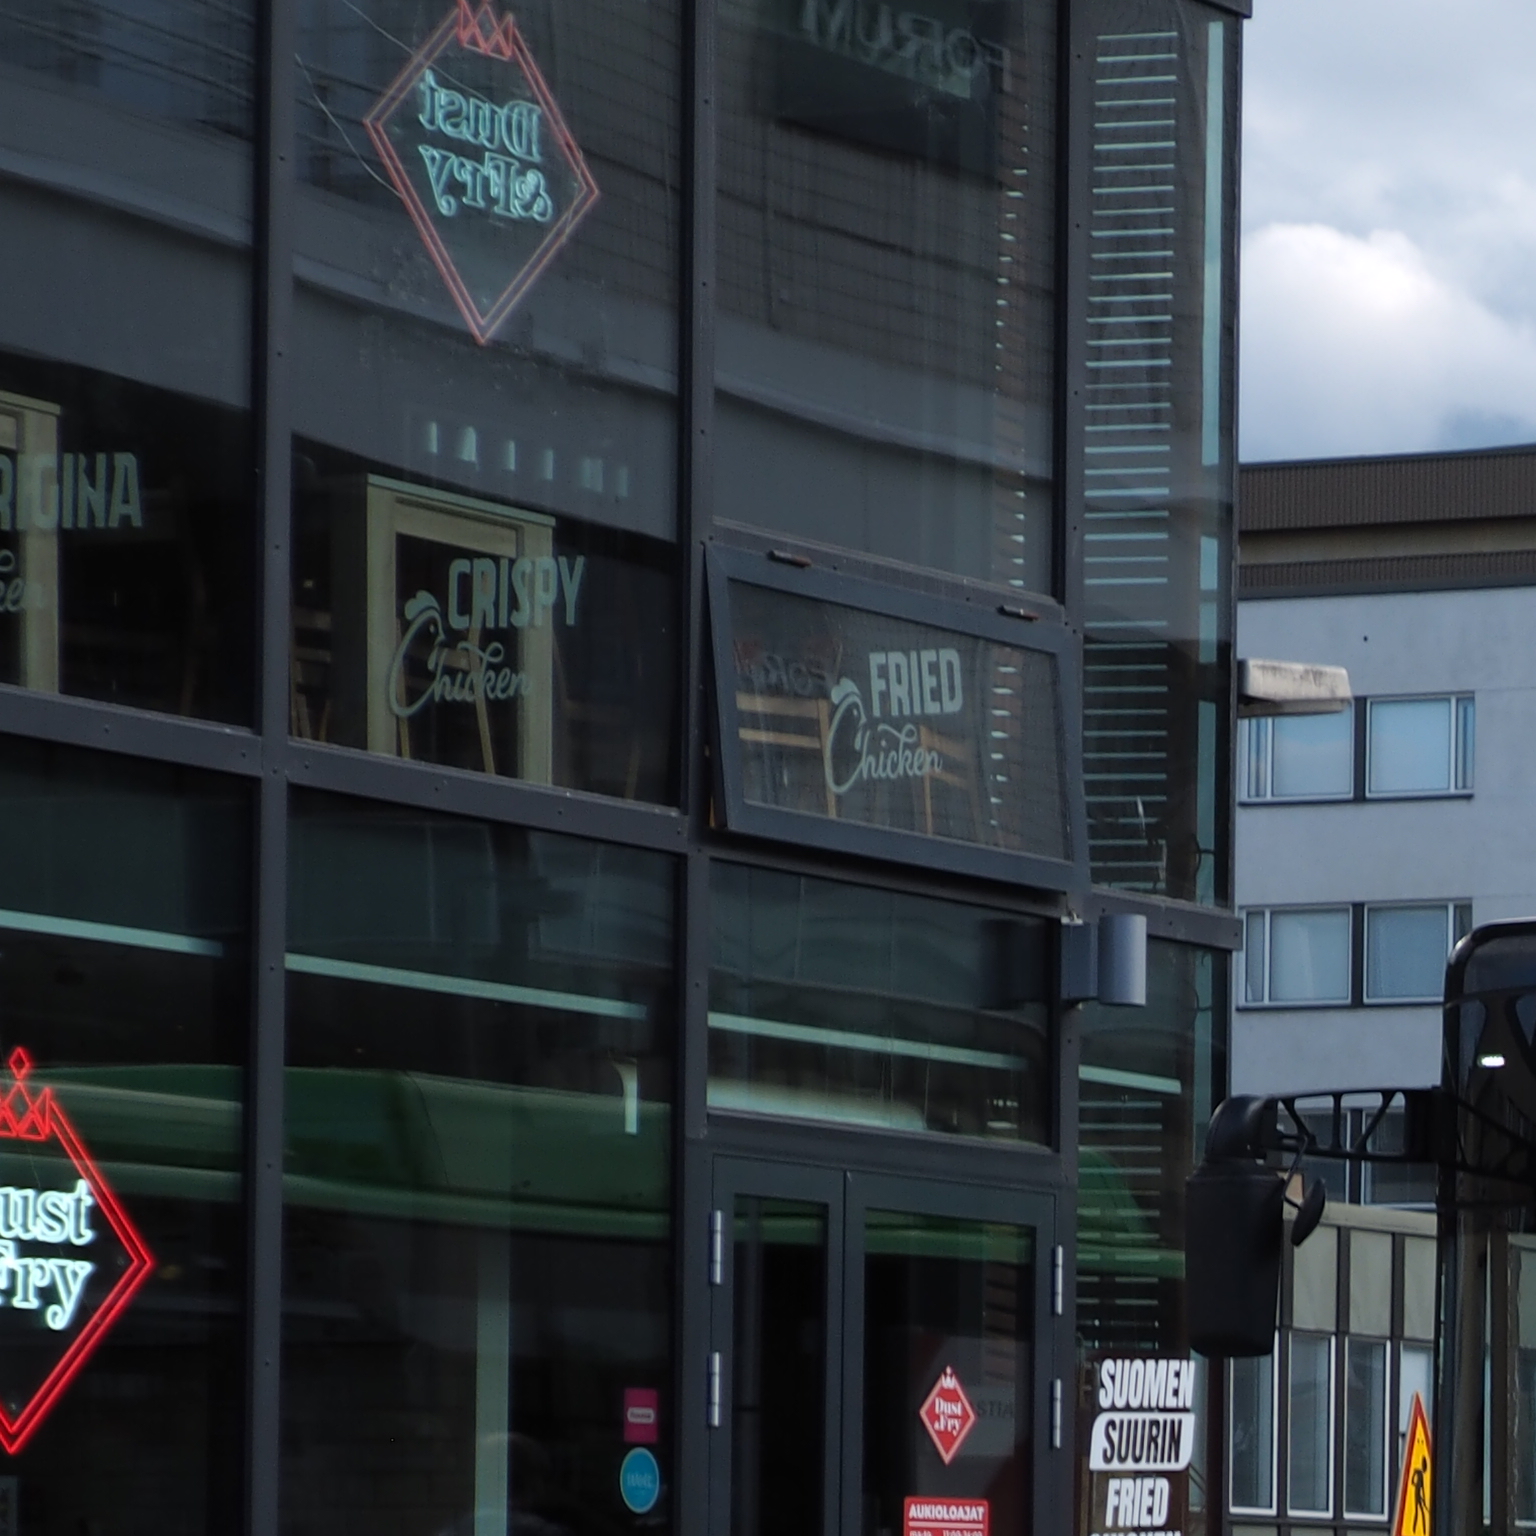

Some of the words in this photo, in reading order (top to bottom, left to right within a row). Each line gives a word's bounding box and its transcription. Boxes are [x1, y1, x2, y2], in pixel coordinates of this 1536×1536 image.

[448, 555, 586, 630] CRISPY
[388, 606, 533, 718] Chicken
[869, 647, 963, 718] FRIED
[825, 692, 942, 793] Chicken
[1098, 1357, 1196, 1410] SUOMEN
[1102, 1417, 1183, 1465] SUURIN
[908, 1503, 985, 1522] AUKIOLOAJAT
[1105, 1476, 1170, 1528] FRIED
